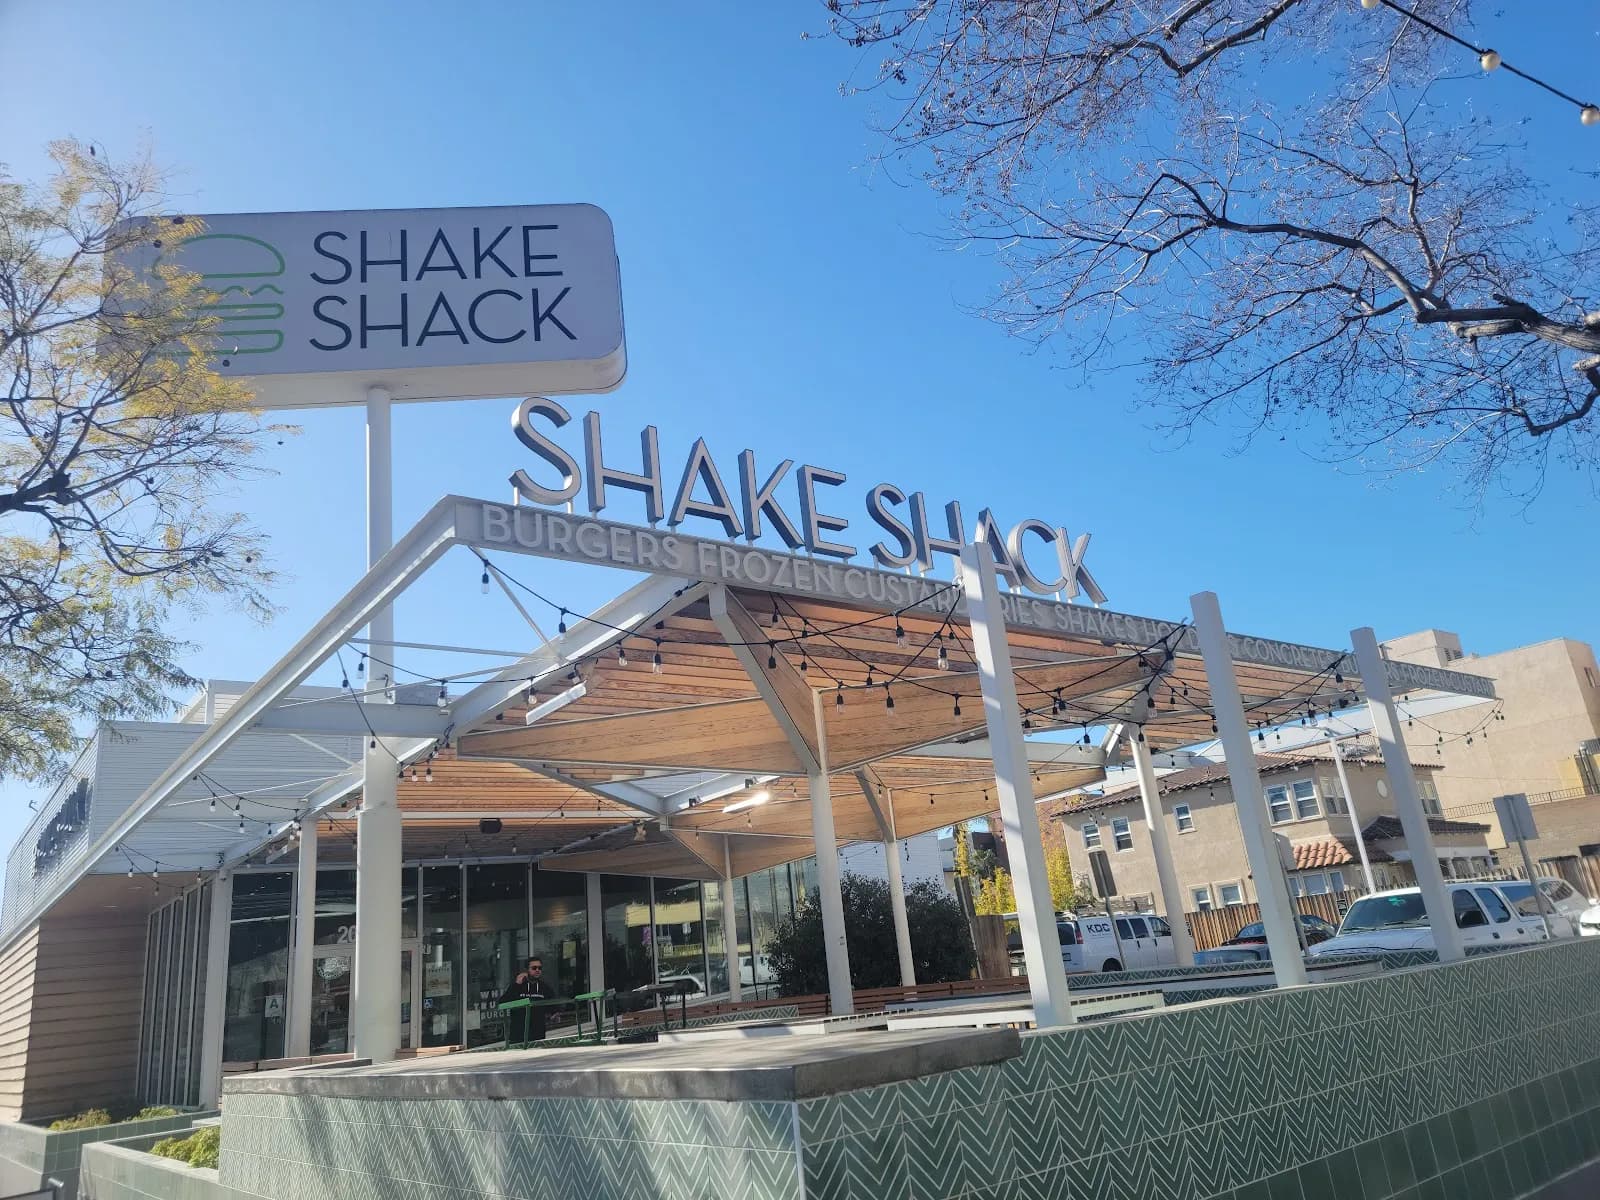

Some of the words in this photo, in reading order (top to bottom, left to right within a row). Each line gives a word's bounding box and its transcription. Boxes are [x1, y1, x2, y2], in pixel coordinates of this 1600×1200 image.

[310, 224, 564, 286] SHAKE
[309, 286, 579, 352] SHACK
[508, 396, 858, 562] SHAKE
[866, 483, 1107, 602] SHACK
[482, 503, 685, 571] BURGERS
[698, 542, 839, 594] FROZEN
[1000, 595, 1042, 627] RIES
[1054, 604, 1138, 641] SHAKES
[1243, 637, 1336, 672] CONCRETES
[1086, 923, 1111, 934] KDC
[270, 998, 279, 1009] A
